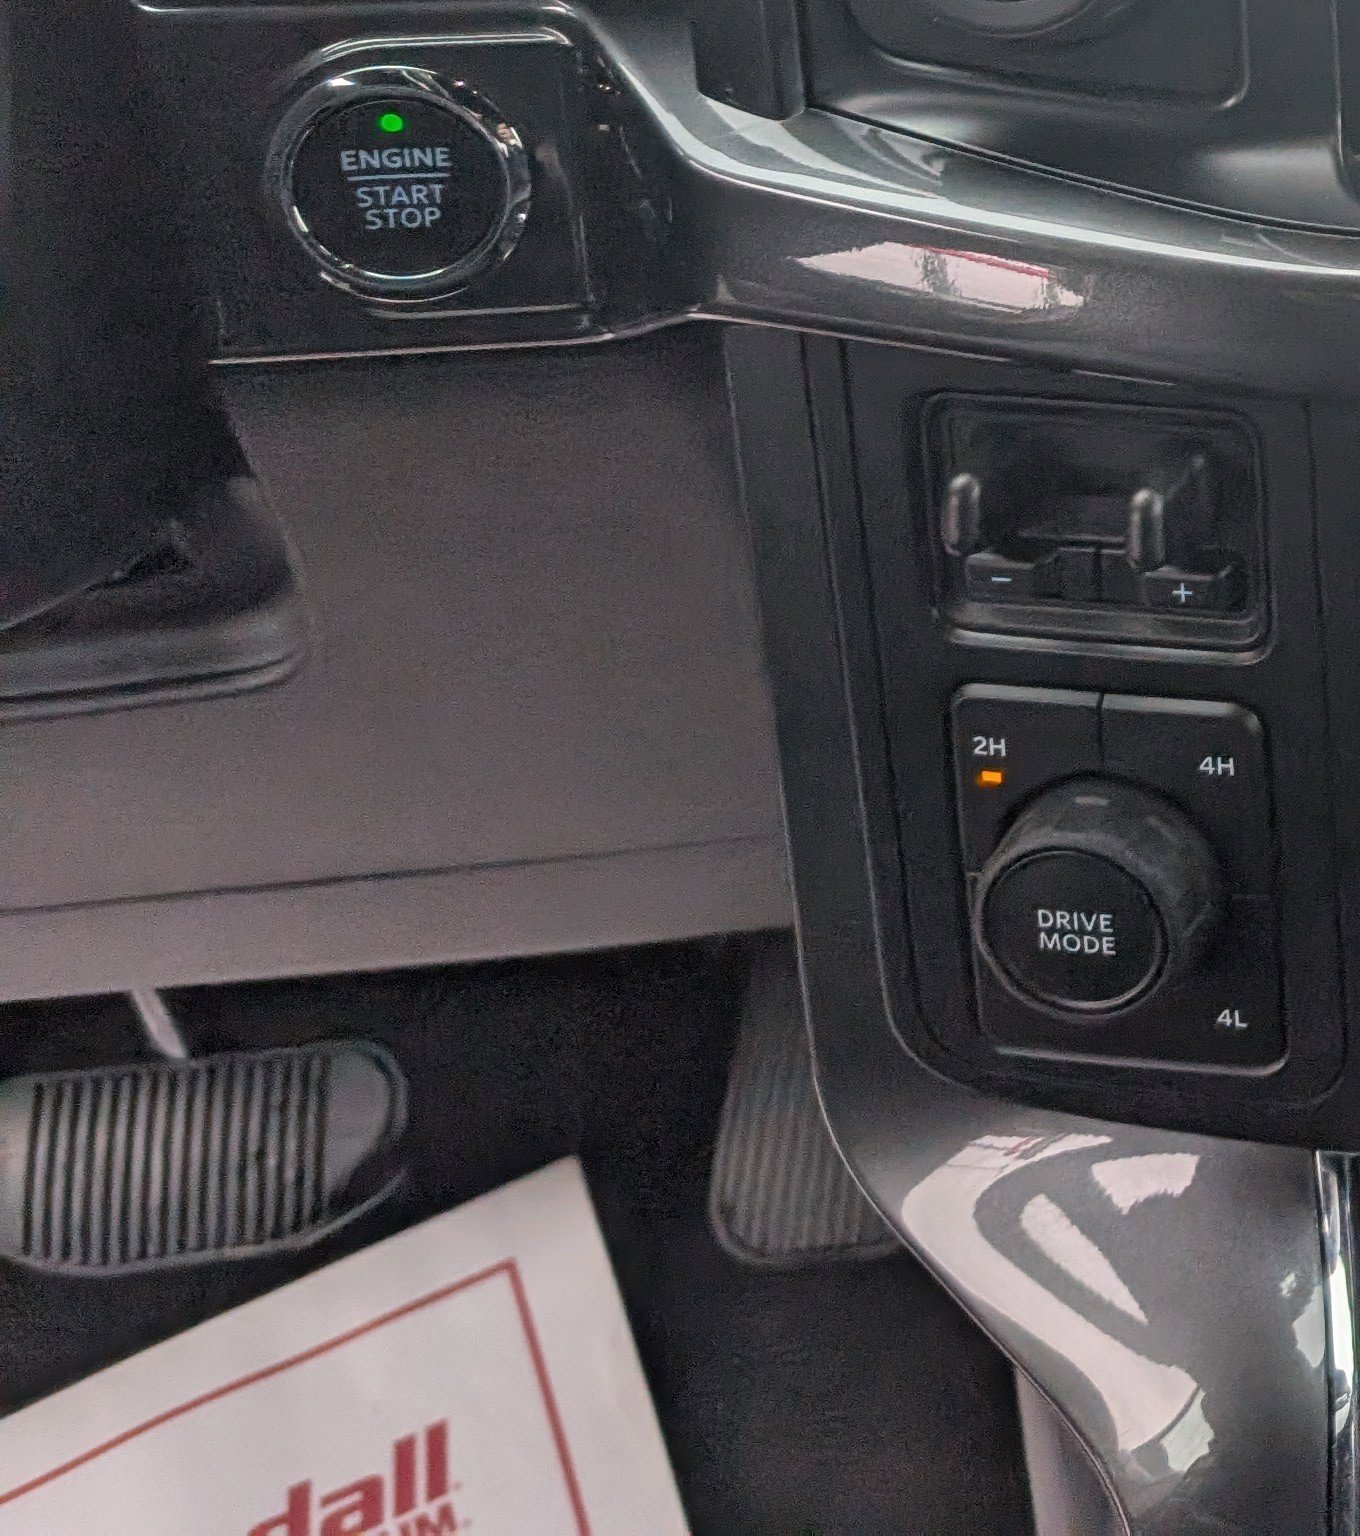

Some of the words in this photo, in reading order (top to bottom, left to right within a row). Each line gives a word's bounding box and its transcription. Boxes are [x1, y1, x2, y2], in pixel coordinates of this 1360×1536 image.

[340, 147, 453, 172] ENGINE
[355, 182, 445, 208] START
[364, 207, 441, 231] STOP
[972, 735, 1008, 758] 2H
[1199, 756, 1236, 778] 4H
[1037, 908, 1114, 933] DRIVE
[1038, 932, 1117, 956] MODE
[1215, 1008, 1249, 1030] 4L
